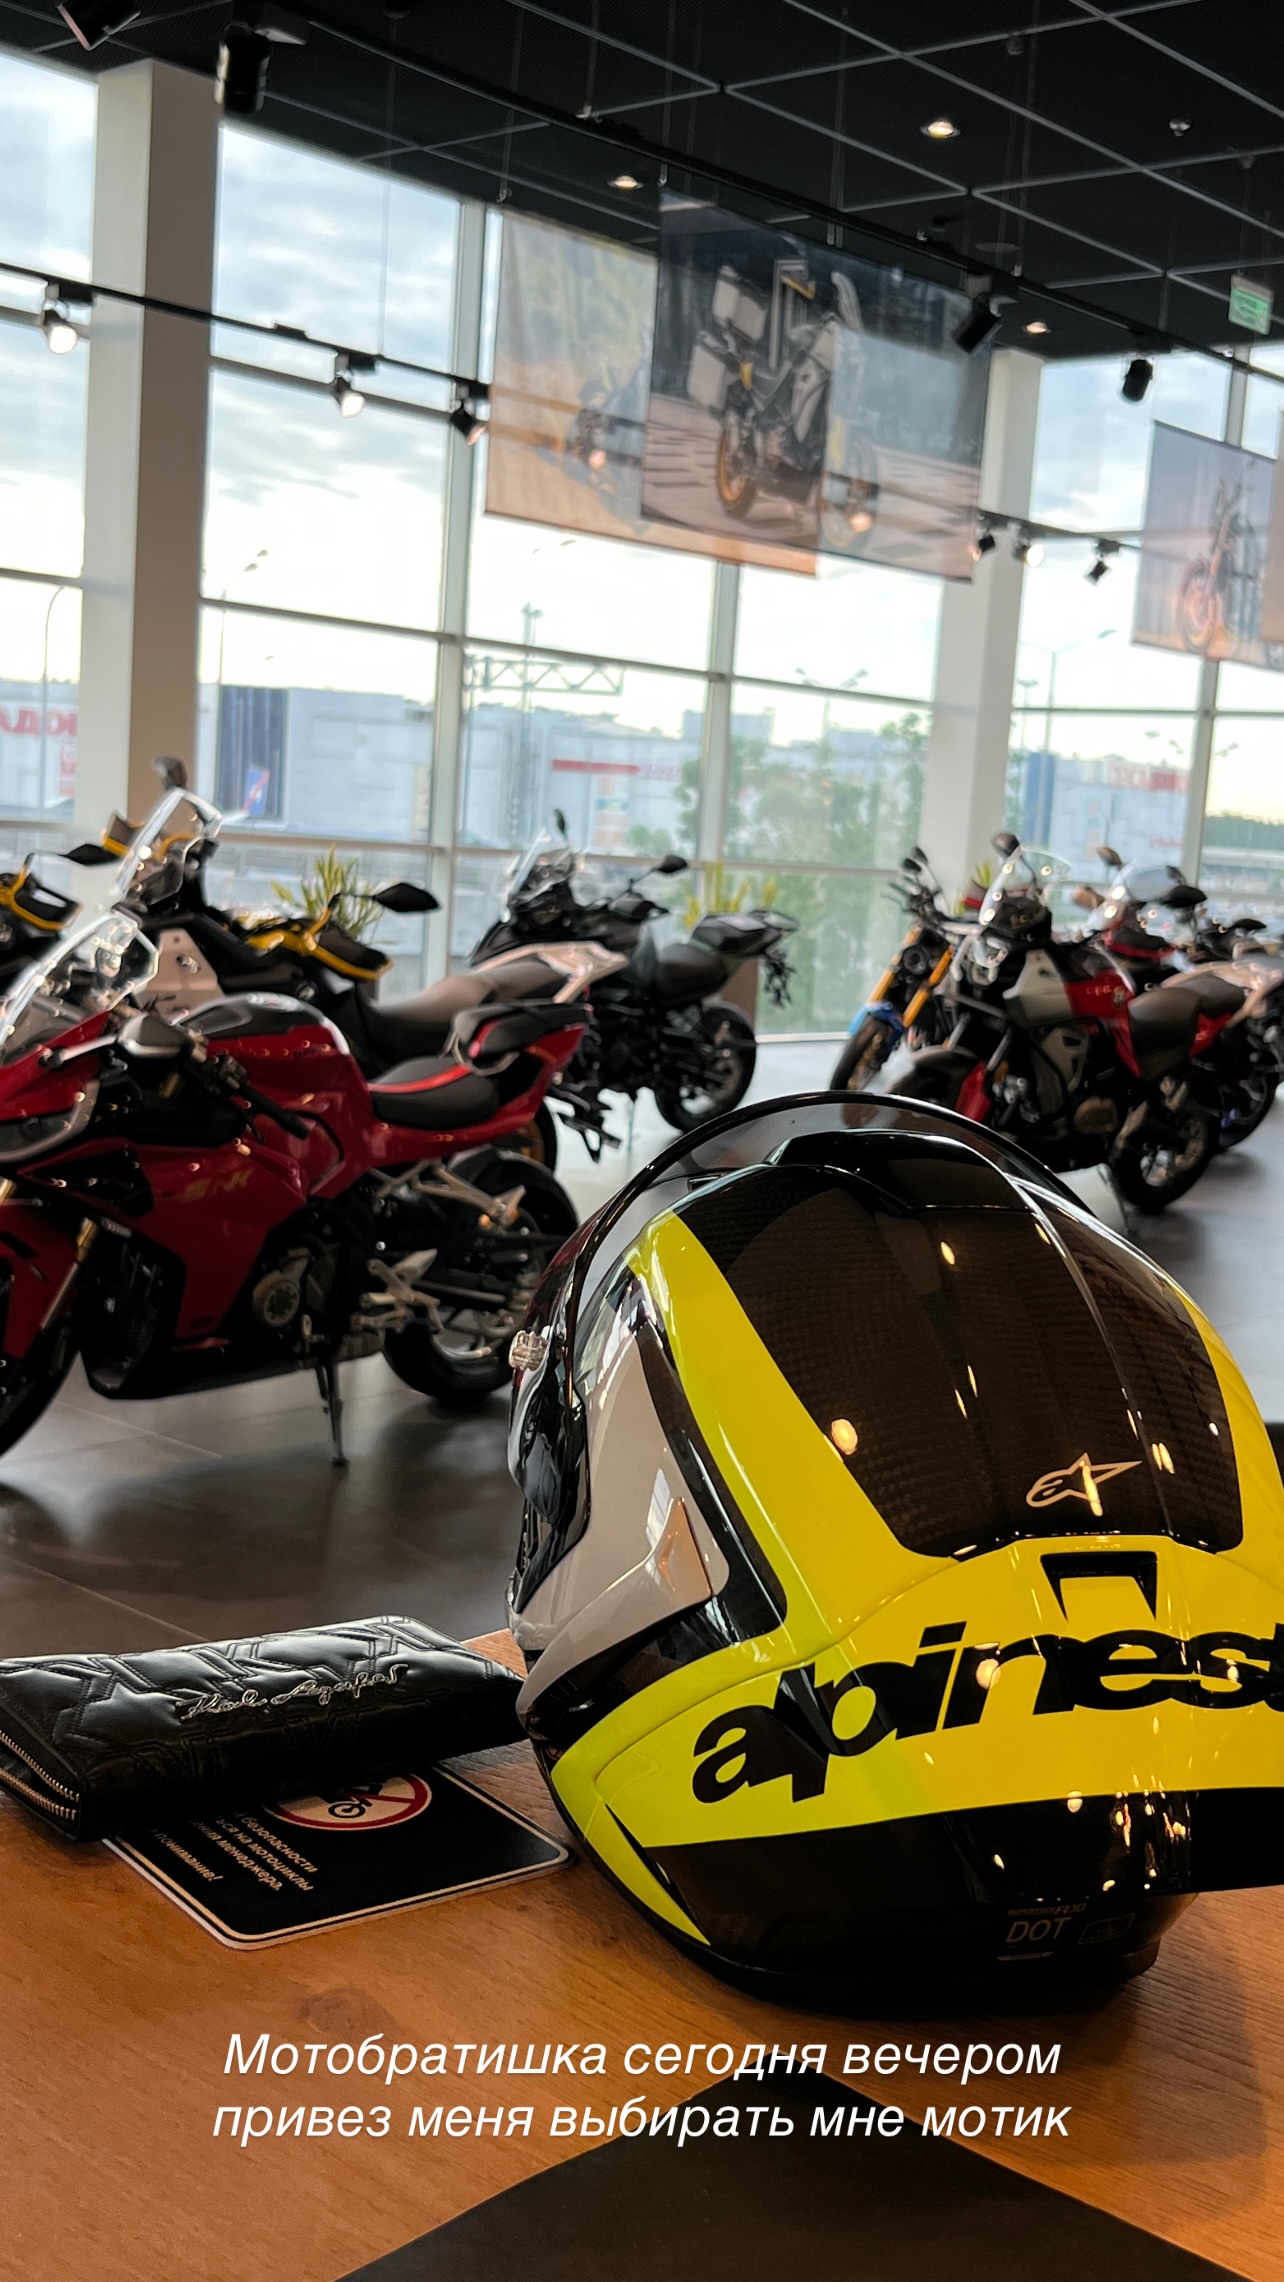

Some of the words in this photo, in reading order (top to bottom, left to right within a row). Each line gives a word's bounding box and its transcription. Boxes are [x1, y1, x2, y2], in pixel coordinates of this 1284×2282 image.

[153, 1831, 225, 1883] понимание!
[233, 1831, 253, 1844] на
[247, 1842, 314, 1892] мотоциклы
[241, 1816, 319, 1873] безопасности
[1005, 1915, 1073, 1944] DOT
